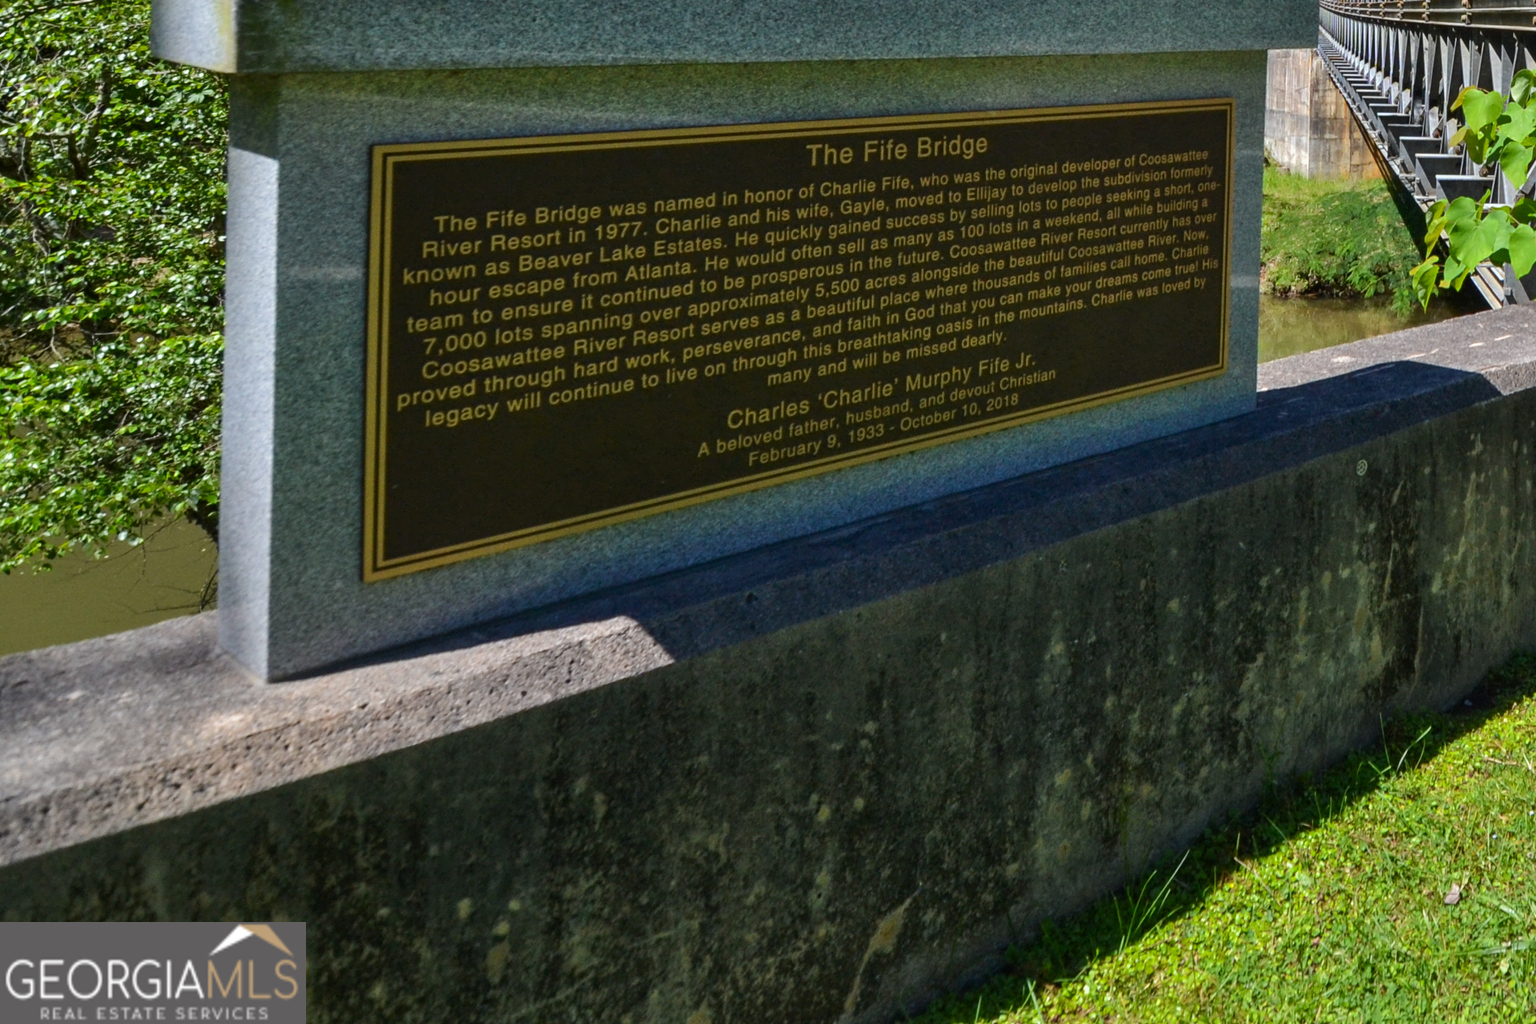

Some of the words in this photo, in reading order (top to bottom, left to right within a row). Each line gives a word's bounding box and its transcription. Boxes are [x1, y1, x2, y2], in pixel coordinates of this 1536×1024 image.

[434, 215, 478, 234] The
[486, 210, 527, 229] Fife
[535, 205, 602, 225] Bridge
[609, 202, 648, 217] was
[655, 192, 717, 214] named
[745, 188, 794, 205] honor
[820, 179, 877, 198] Charlie
[882, 176, 915, 192] Fife,
[920, 173, 949, 188] who
[954, 172, 981, 184] was
[985, 168, 1007, 182] the
[1010, 162, 1058, 181] original
[1062, 159, 1122, 174] developer
[1139, 151, 1209, 167] Coosawattee
[806, 144, 854, 167] The
[864, 139, 908, 163] Fife
[918, 135, 988, 160] Bridge
[403, 265, 477, 286] known
[519, 252, 594, 273] Beaver
[600, 244, 647, 263] Lake
[654, 237, 728, 257] Estates.
[765, 224, 824, 247] quickly
[829, 217, 882, 240] gained
[886, 212, 945, 230] success
[971, 204, 1015, 220] selling
[1019, 200, 1042, 214] lots
[1062, 193, 1103, 212] people
[1106, 188, 1151, 204] seeking
[423, 240, 483, 259] River
[491, 230, 562, 252] Resort
[595, 221, 648, 241] 1977.
[656, 214, 722, 235] Charlie
[728, 209, 761, 228] and
[767, 207, 791, 223] his
[797, 203, 834, 220] wife,
[841, 198, 890, 217] Gayle,
[896, 191, 944, 209] moved
[967, 186, 1008, 203] Ellijay
[1028, 179, 1078, 195] develop
[1081, 176, 1101, 190] the
[1104, 170, 1167, 187] subdivision
[1171, 165, 1214, 180] formerly
[430, 288, 482, 307] hour
[489, 278, 566, 299] escape
[573, 271, 619, 289] from
[625, 262, 698, 282] Atlanta.
[736, 247, 786, 268] would
[791, 245, 833, 261] often
[838, 238, 866, 255] sell
[894, 233, 934, 248] many
[961, 224, 985, 239] 100
[989, 222, 1013, 235] lots
[1045, 209, 1103, 228] weekend,
[1124, 204, 1154, 218] while
[1157, 199, 1199, 214] building
[407, 314, 464, 334] team
[501, 299, 574, 321] ensure
[600, 280, 694, 308] continued
[752, 263, 845, 291] prosperous
[869, 256, 893, 271] the
[898, 251, 945, 267] future.
[950, 237, 1037, 259] Coosawattee
[1041, 232, 1074, 246] River
[1078, 225, 1117, 241] Resort
[1120, 218, 1169, 235] currently
[1195, 213, 1218, 225] over
[422, 346, 566, 380] Coosawattee
[574, 336, 627, 357] River
[633, 323, 696, 347] Resort
[701, 316, 760, 336] serves
[807, 294, 875, 319] beautiful
[880, 291, 921, 311] place
[925, 283, 968, 300] where
[973, 270, 1041, 293] thousands
[1061, 261, 1108, 278] families
[1111, 255, 1131, 270] call
[1172, 244, 1210, 260] Charlie
[423, 331, 488, 356] 7,000
[495, 327, 534, 346] lots
[542, 313, 634, 341] spanning
[640, 306, 682, 324] over
[688, 286, 810, 319] approximately
[816, 278, 861, 299] 5,500
[865, 274, 907, 291] acres
[912, 262, 980, 284] alongside
[985, 259, 1006, 273] the
[1010, 248, 1065, 269] beautiful
[1069, 239, 1145, 260] Coosawattee
[397, 378, 477, 412] proved
[484, 366, 567, 394] through
[574, 356, 619, 379] hard
[625, 348, 676, 370] work,
[683, 329, 806, 364] perseverance,
[813, 319, 843, 338] and
[848, 314, 882, 332] faith
[905, 304, 936, 322] God
[940, 300, 967, 316] that
[971, 297, 996, 315] you
[1000, 293, 1024, 306] can
[1028, 285, 1062, 301] make
[1066, 281, 1093, 298] your
[1095, 273, 1139, 290] dreams
[1142, 268, 1172, 282] come
[425, 402, 500, 428] legacy
[507, 391, 542, 413] will
[549, 379, 635, 406] continue
[666, 368, 698, 385] live
[733, 348, 798, 373] through
[803, 342, 833, 360] this
[838, 327, 932, 354] breathtaking
[937, 317, 974, 336] oasis
[995, 311, 1016, 325] the
[1020, 299, 1087, 320] mountains.
[1092, 289, 1134, 307] Charlie
[1137, 286, 1159, 299] was
[1162, 278, 1191, 294] loved
[768, 368, 813, 387] many
[818, 358, 847, 377] and
[853, 352, 878, 370] will
[906, 337, 957, 360] missed
[961, 330, 1007, 349] dearly.
[697, 442, 711, 459] A
[717, 426, 783, 454] beloved
[789, 417, 840, 438] father,
[846, 399, 914, 426] husband,
[919, 391, 945, 410] and
[950, 381, 996, 402] devout
[1000, 370, 1057, 391] Christian
[727, 400, 810, 430] Charles
[906, 366, 973, 393] Murphy
[979, 357, 1010, 377] Fife
[1015, 352, 1036, 370] Jr.
[749, 440, 822, 467] February
[828, 434, 841, 449] 9,
[849, 423, 885, 444] 1933
[900, 409, 957, 432] October
[962, 402, 982, 417] 10,
[986, 393, 1019, 412] 2018
